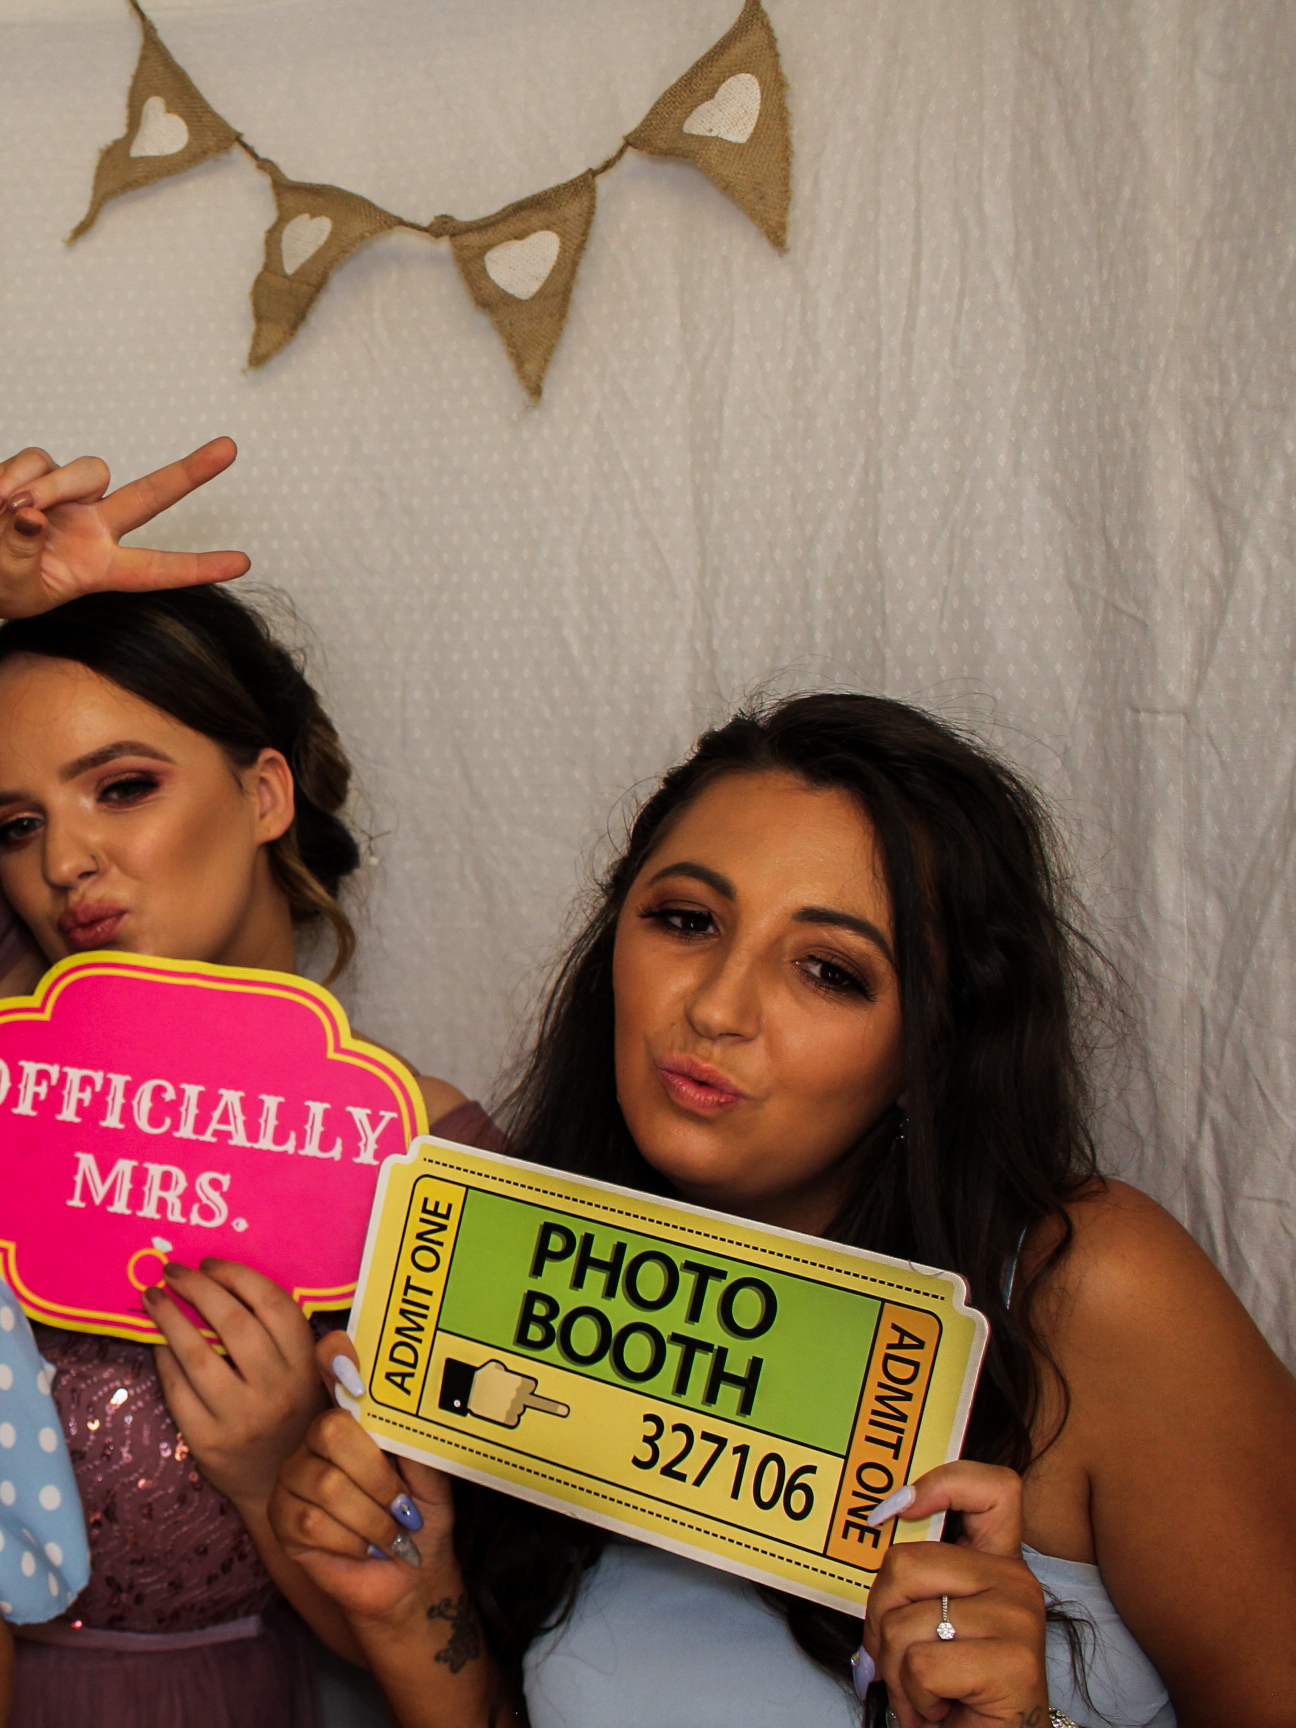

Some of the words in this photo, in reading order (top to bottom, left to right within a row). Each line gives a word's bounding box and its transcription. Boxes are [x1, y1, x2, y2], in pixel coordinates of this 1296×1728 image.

[66, 1152, 249, 1233] MRS.
[384, 1275, 434, 1396] ADMIT
[410, 1196, 453, 1273] ONE
[529, 1221, 779, 1340] PHOTO
[514, 1290, 765, 1418] BOOTH
[864, 1322, 926, 1461] ADMIT
[631, 1413, 819, 1522] 327106
[841, 1461, 894, 1549] ONE
